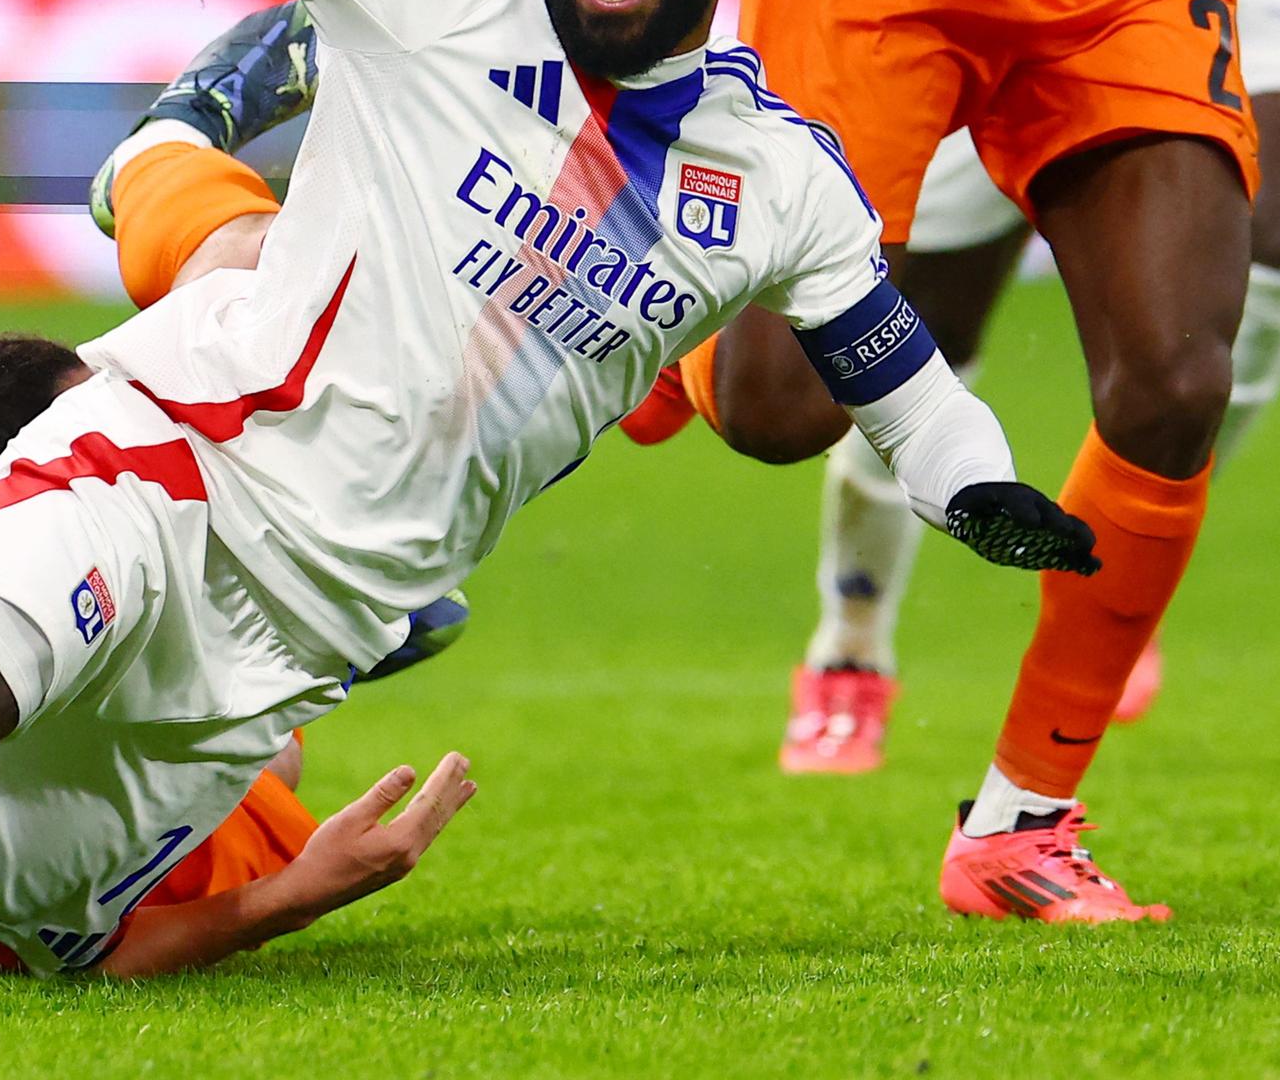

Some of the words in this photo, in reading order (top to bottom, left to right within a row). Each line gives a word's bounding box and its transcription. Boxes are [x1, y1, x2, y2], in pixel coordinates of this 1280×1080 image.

[683, 178, 737, 200] LYONNAIS
[684, 168, 739, 189] OLYMPIQUE
[456, 146, 697, 330] Emirates
[681, 198, 730, 242] OL
[452, 238, 524, 297] FLY
[509, 275, 631, 364] BETTER
[97, 825, 193, 918] 1
